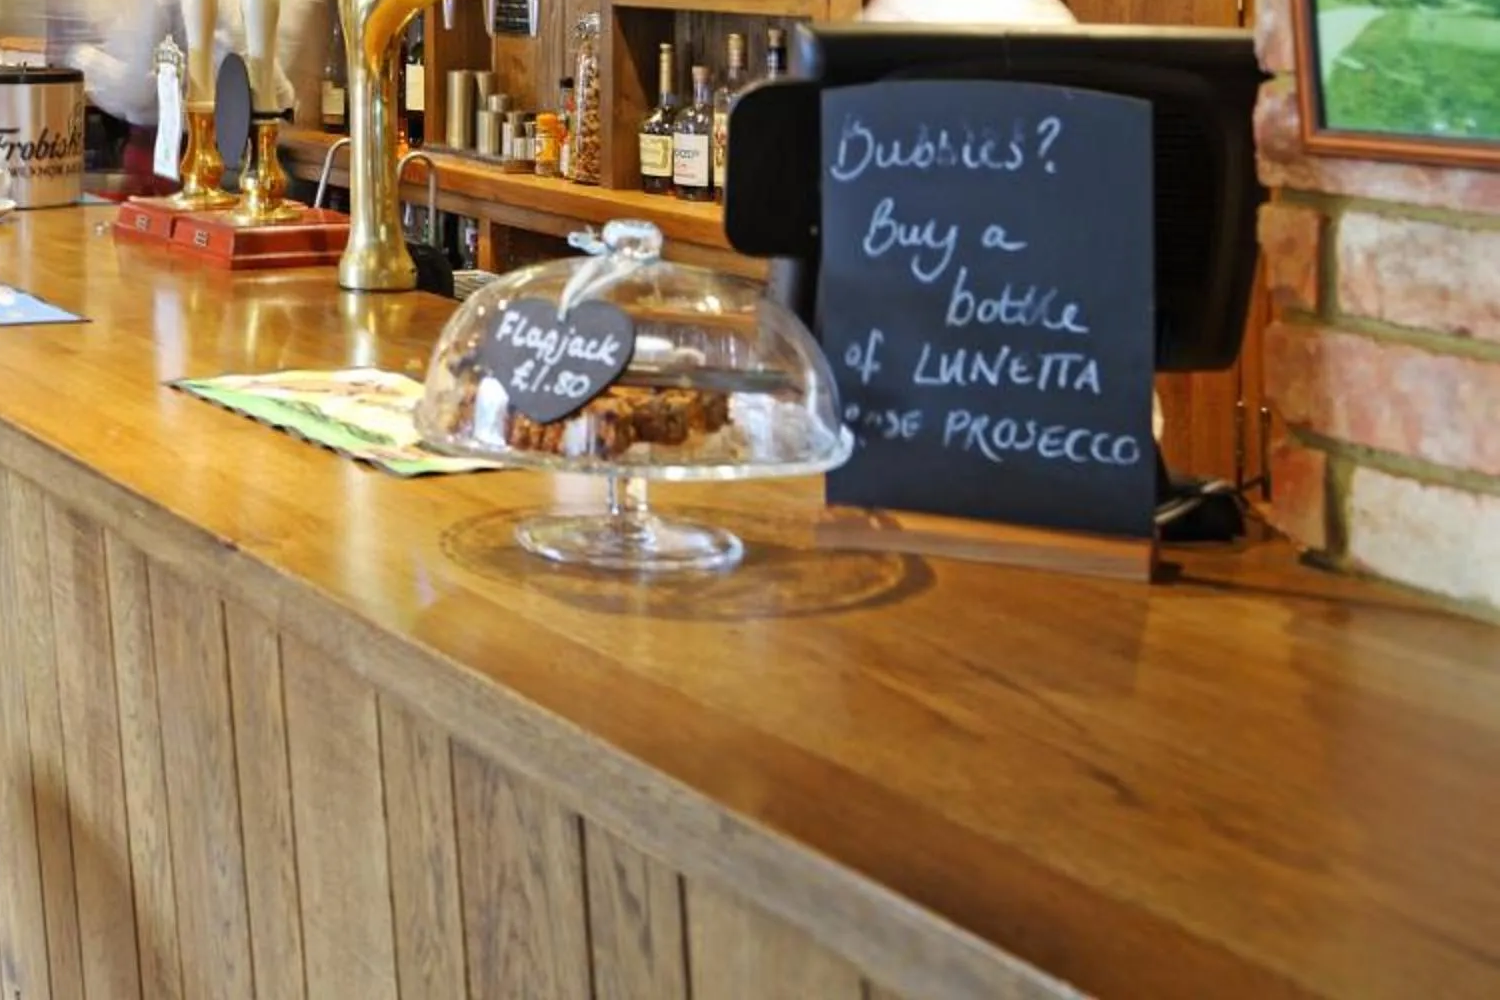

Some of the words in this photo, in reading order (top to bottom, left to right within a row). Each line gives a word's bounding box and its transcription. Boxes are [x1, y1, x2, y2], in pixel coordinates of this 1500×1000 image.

[863, 197, 959, 283] Buy
[982, 223, 1028, 252] a
[945, 265, 1090, 333] bottle
[510, 359, 591, 399] £1.80
[845, 328, 884, 385] of
[913, 344, 1101, 393] LUNETTA
[943, 409, 1141, 465] PROSECCO
